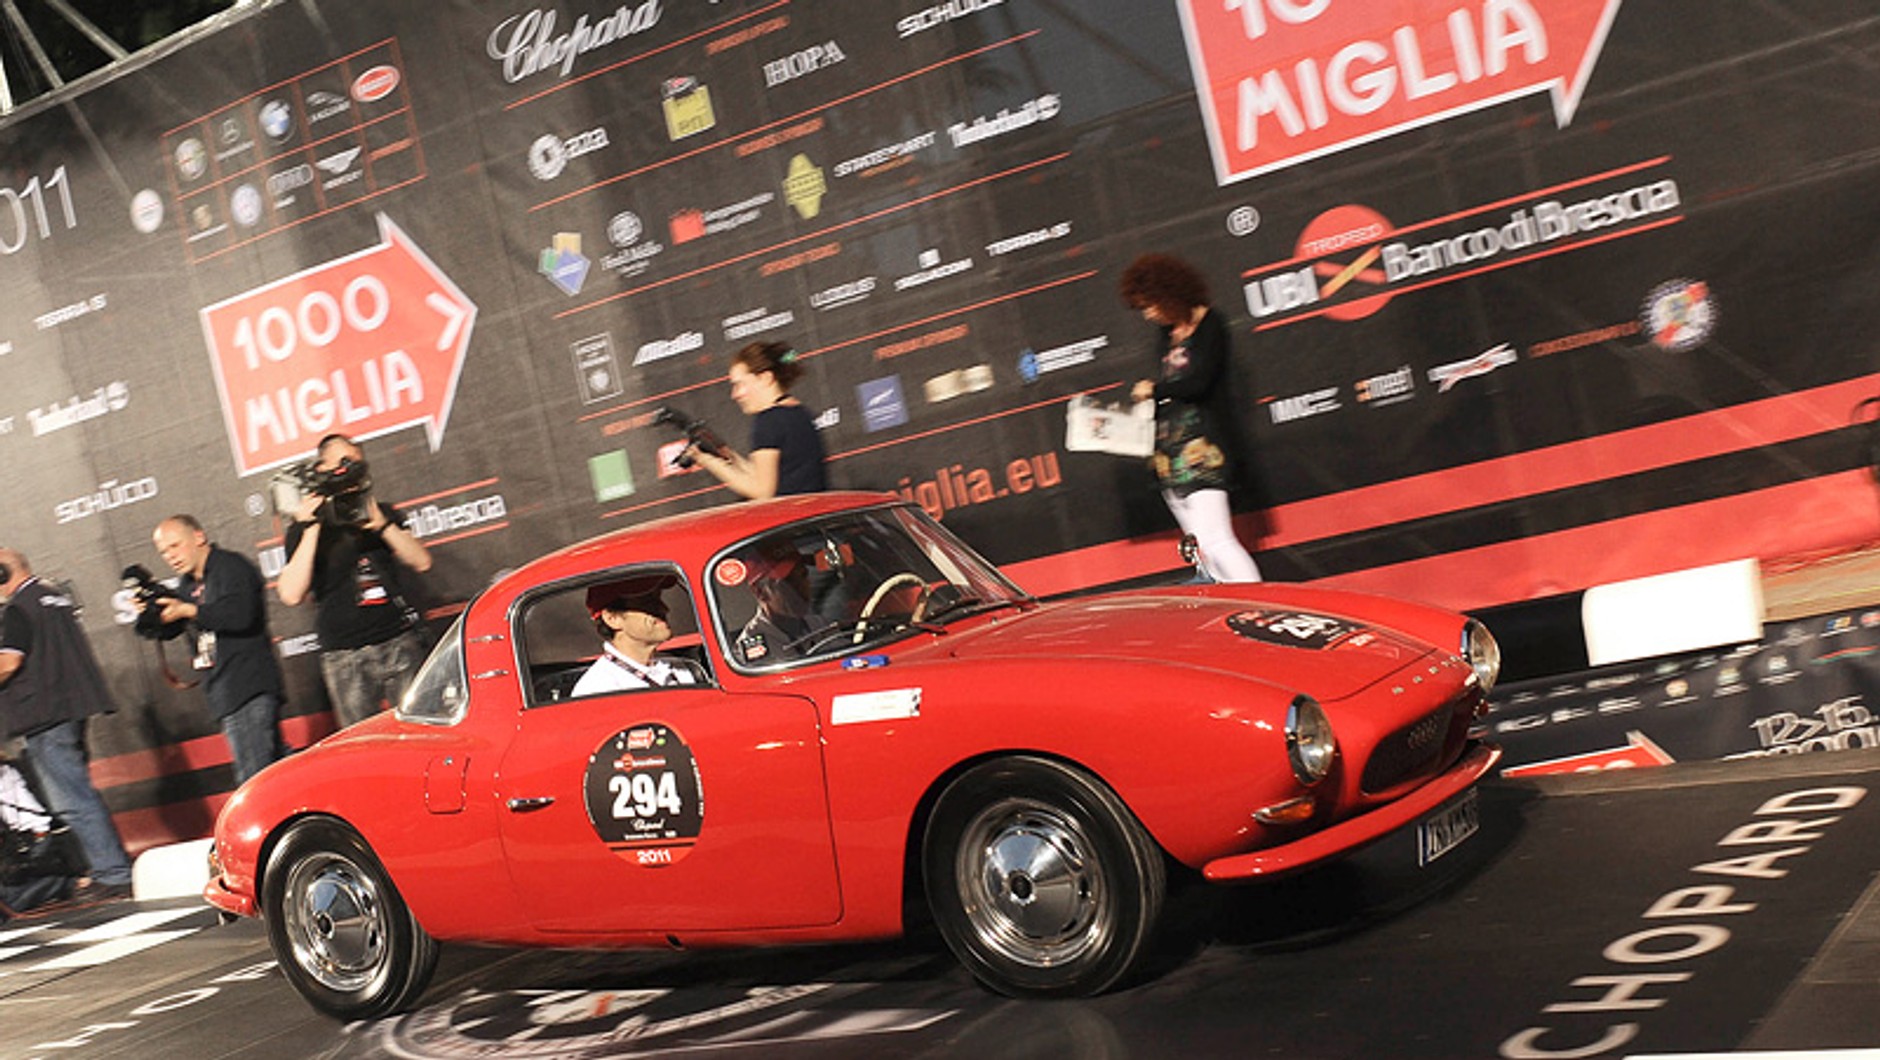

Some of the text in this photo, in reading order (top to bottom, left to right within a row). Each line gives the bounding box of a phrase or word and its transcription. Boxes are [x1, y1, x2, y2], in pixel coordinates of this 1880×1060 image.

[487, 0, 663, 83] Chopard
[763, 40, 846, 88] HOPA
[1238, 0, 1549, 153] MIGLIA
[1243, 265, 1320, 318] UBI
[1533, 179, 1680, 242] Brescia
[232, 273, 390, 371] 1000
[244, 350, 424, 453] MIGLIA
[609, 771, 682, 819] 294
[636, 849, 672, 863] 2011
[1498, 786, 1869, 1060] CHOPARD
